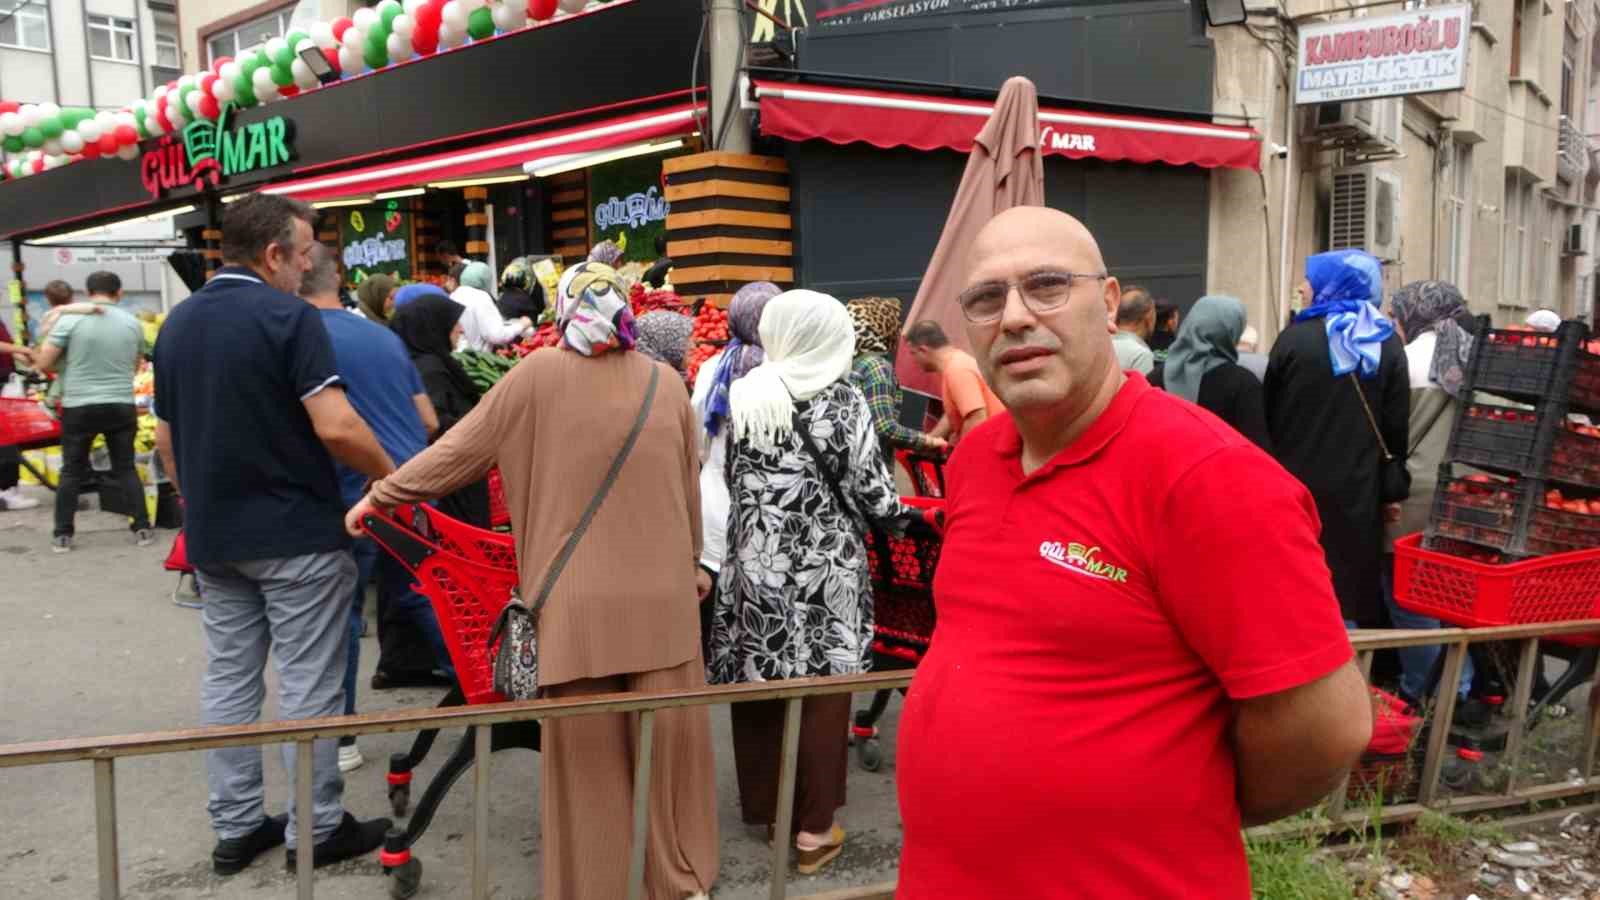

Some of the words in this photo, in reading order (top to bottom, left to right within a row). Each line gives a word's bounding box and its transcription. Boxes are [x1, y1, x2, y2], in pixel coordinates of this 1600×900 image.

[1305, 16, 1461, 65] KAMBUROĞLU
[1302, 54, 1456, 90] MATBAACILIK
[142, 136, 190, 199] GÜL
[223, 116, 289, 176] MAR
[1051, 131, 1096, 151] MAR
[1040, 541, 1065, 561] GÜL
[1085, 557, 1127, 583] MAR
